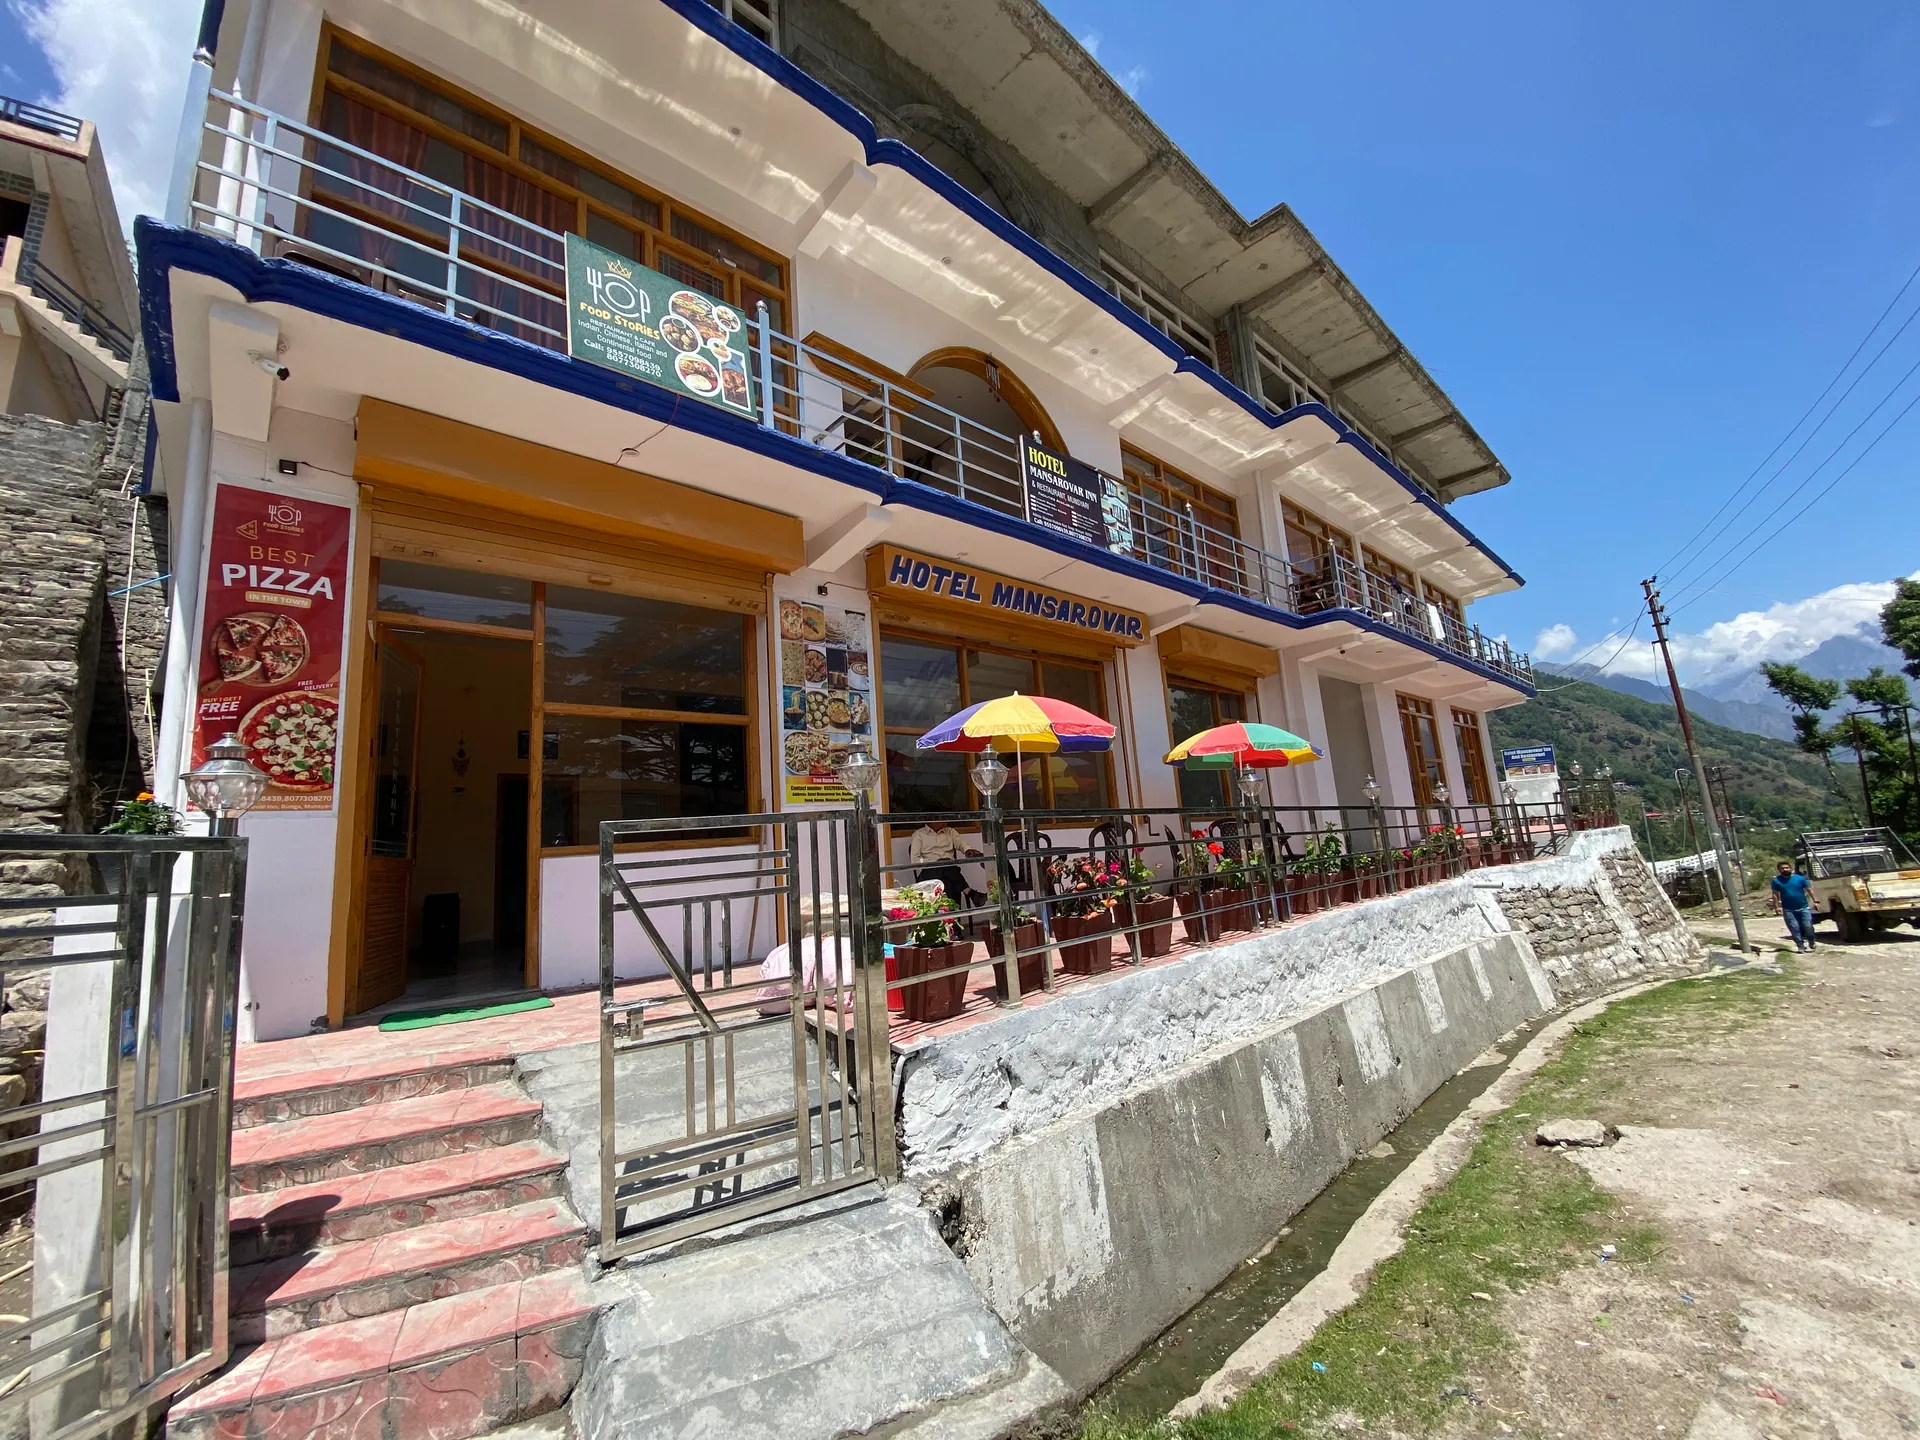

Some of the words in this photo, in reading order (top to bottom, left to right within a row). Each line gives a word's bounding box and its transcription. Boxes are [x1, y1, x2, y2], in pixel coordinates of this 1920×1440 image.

[579, 302, 611, 320] FOOD
[590, 318, 633, 338] RESTAURANT
[640, 338, 655, 347] CAFE
[584, 338, 604, 351] Call:
[597, 334, 634, 353] Continental
[636, 348, 651, 360] food
[635, 341, 654, 353] Italian
[656, 349, 667, 358] and
[1028, 446, 1067, 478] HOTEL
[1030, 465, 1084, 498] MANSAROVAR
[1085, 490, 1098, 503] INN
[1032, 480, 1036, 488] &
[250, 546, 315, 566] BEST
[222, 564, 333, 600] PIZZA
[280, 597, 308, 606] TOWN
[890, 554, 982, 603] HOTEL
[992, 581, 1144, 640] MANSAROVAR
[304, 682, 334, 691] DELIVERY
[199, 701, 240, 713] FREE
[390, 684, 402, 826] RESTAURANT
